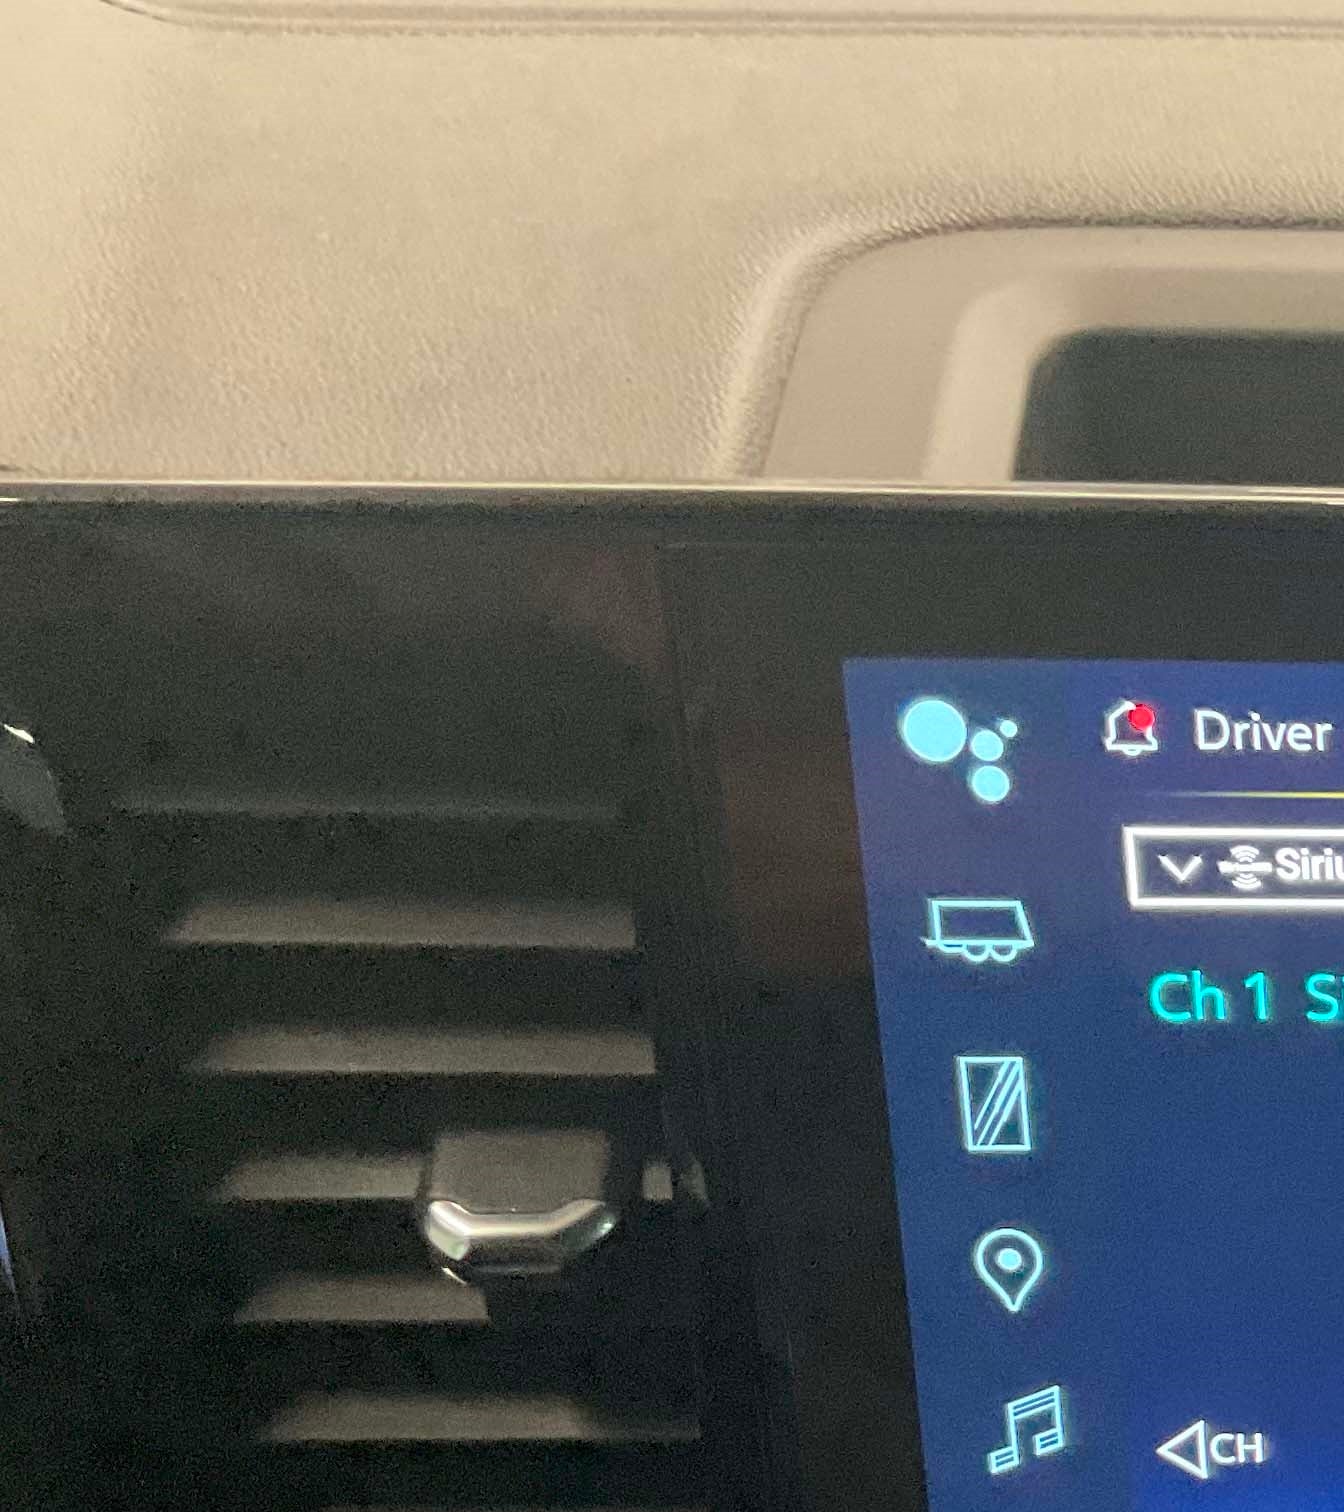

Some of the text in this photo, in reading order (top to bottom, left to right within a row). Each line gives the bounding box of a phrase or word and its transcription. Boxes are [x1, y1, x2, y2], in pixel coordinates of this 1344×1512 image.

[1194, 708, 1333, 752] Driver
[1148, 970, 1226, 1022] Ch
[1244, 972, 1269, 1021] 1
[1209, 1432, 1266, 1464] CH
